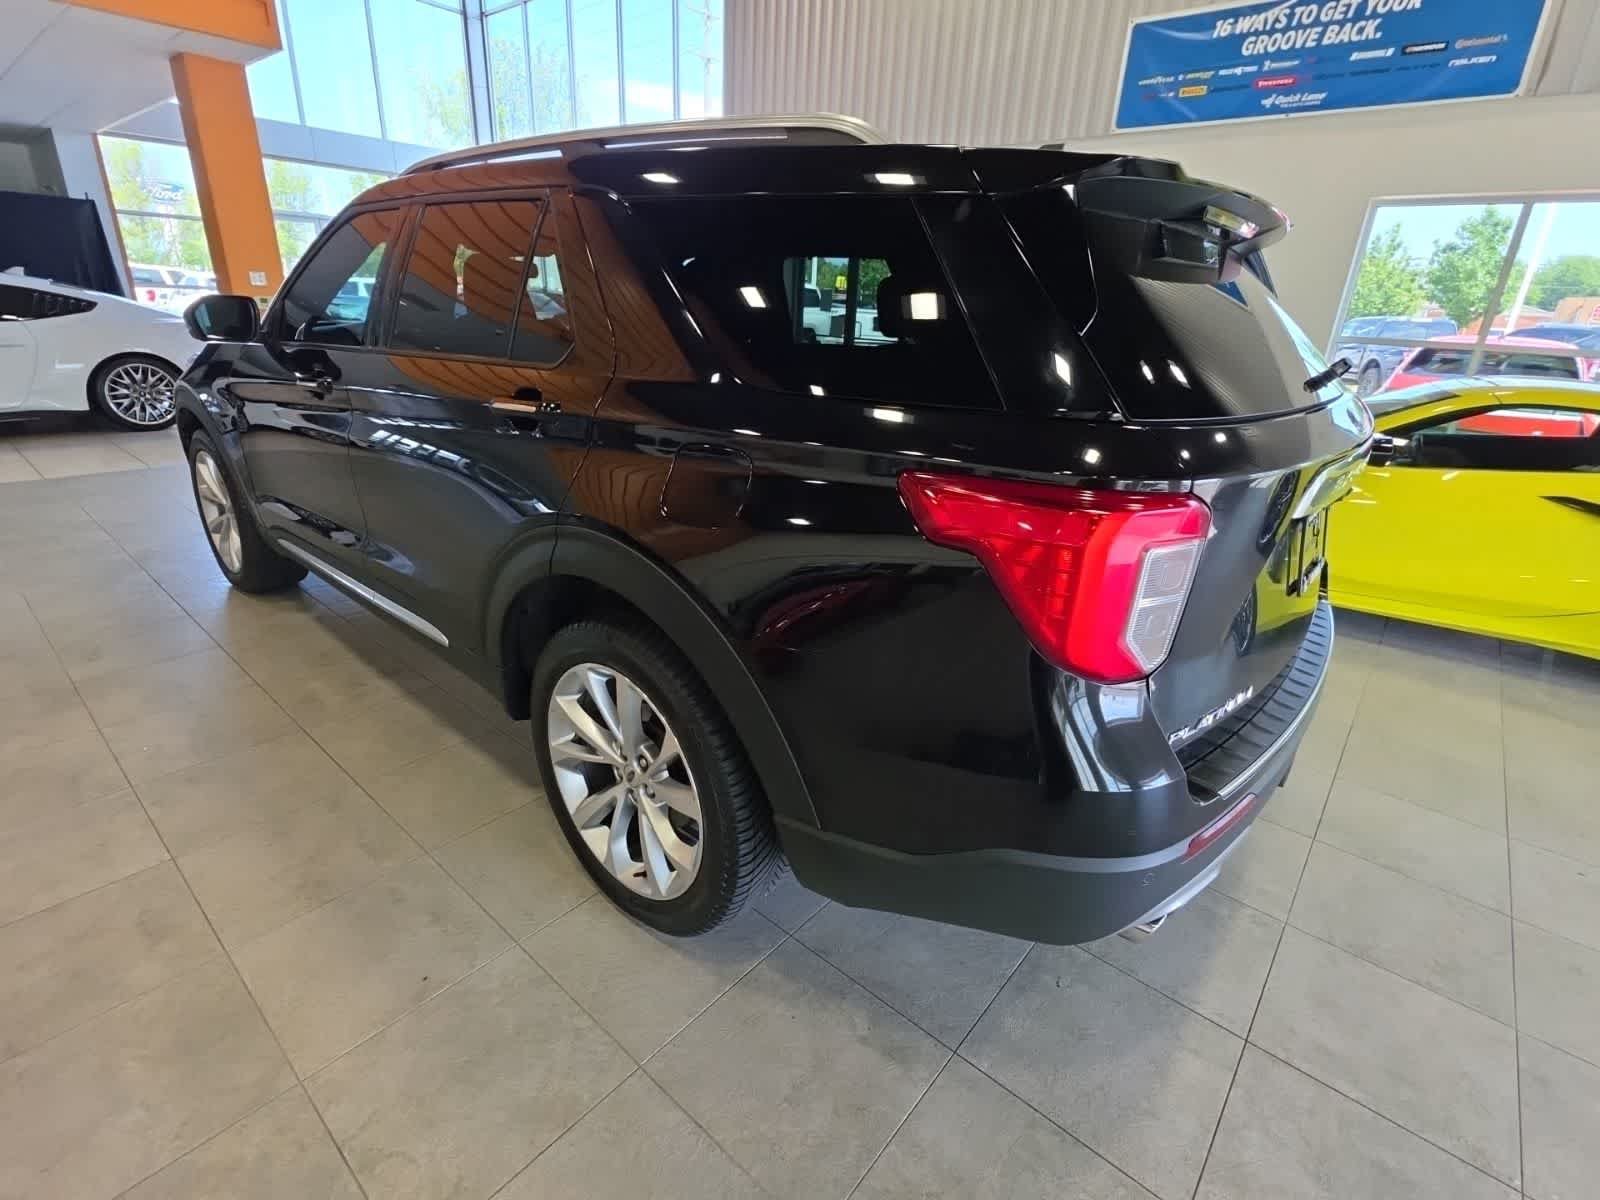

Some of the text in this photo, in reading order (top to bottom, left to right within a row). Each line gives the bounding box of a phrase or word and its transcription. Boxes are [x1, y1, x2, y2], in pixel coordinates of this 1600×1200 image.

[1212, 18, 1235, 39] 16
[1235, 7, 1290, 34] WAYS
[1291, 4, 1318, 27] TO
[1320, 0, 1358, 23] GET
[1241, 26, 1323, 56] GROOVE
[1321, 18, 1383, 46] BACK.
